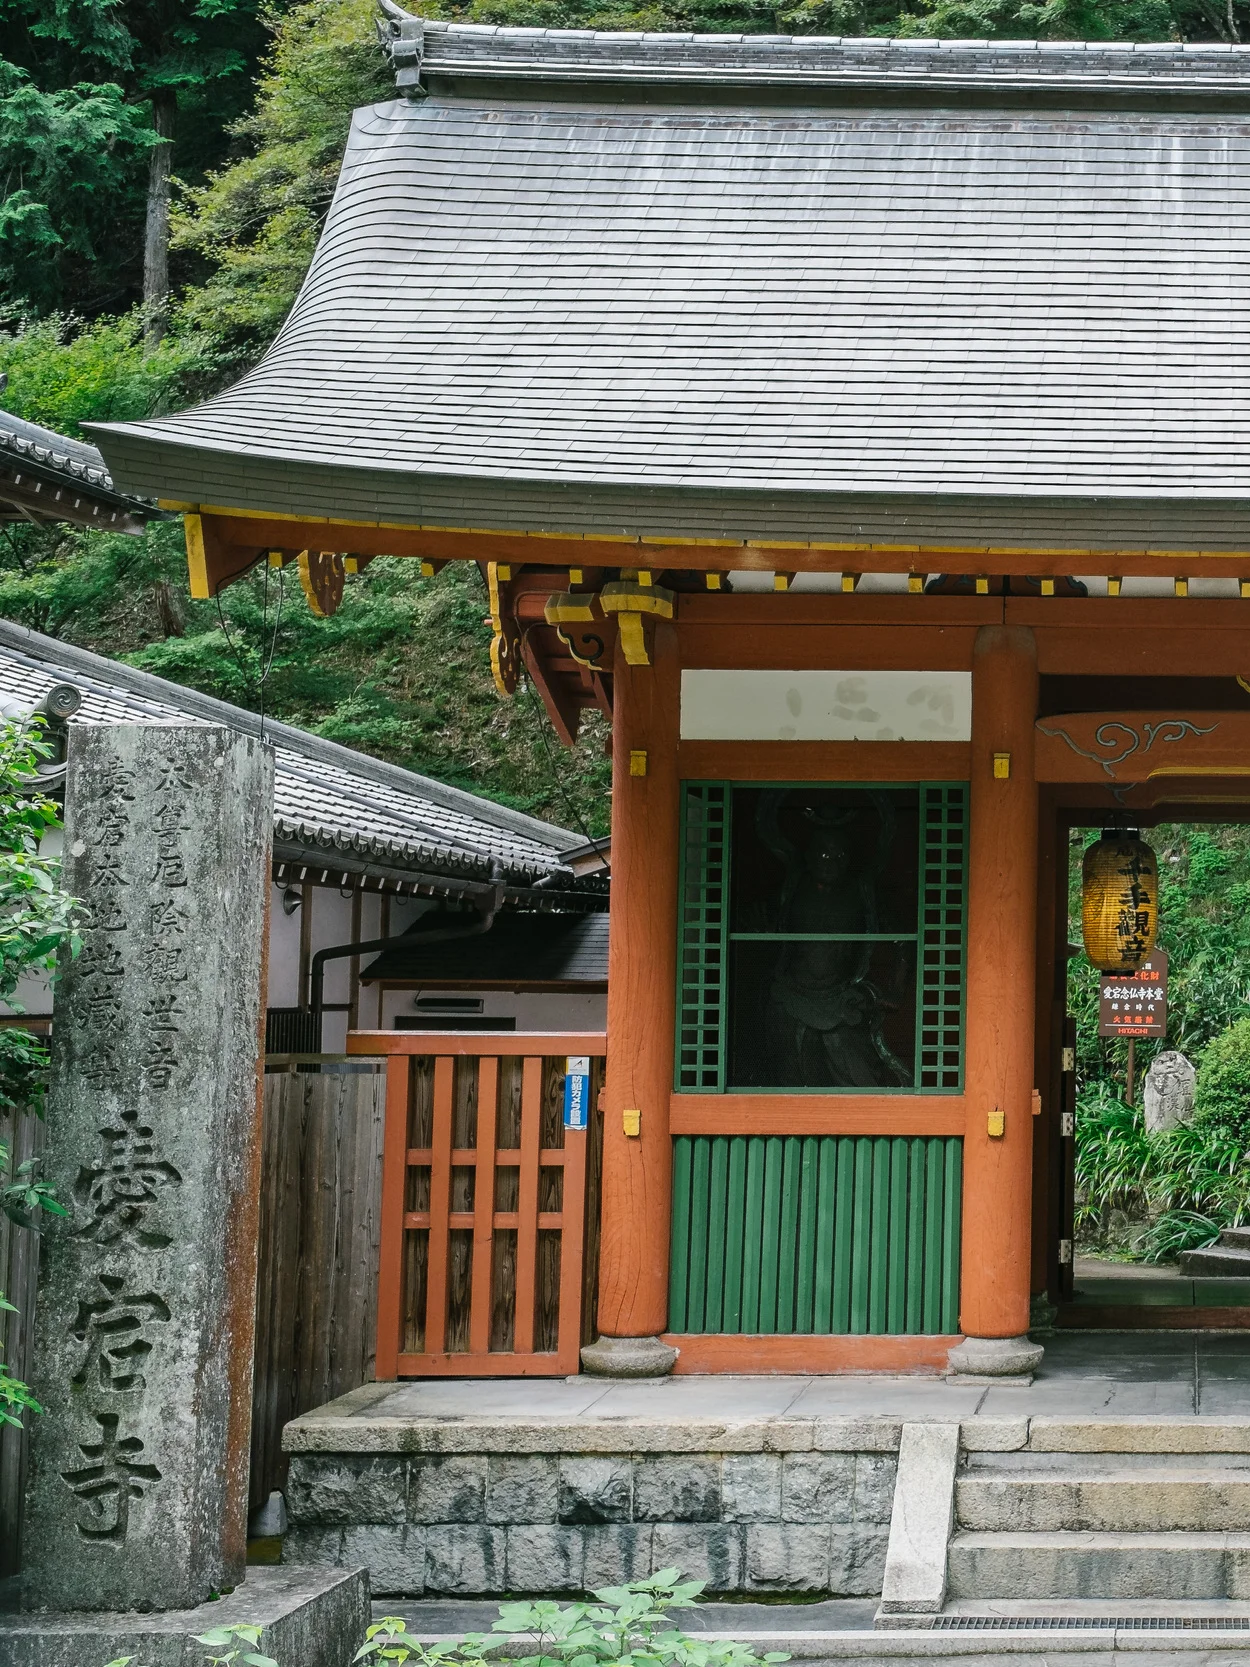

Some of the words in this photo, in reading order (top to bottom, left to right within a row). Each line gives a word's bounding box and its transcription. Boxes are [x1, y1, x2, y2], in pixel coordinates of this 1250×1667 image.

[1103, 986, 1164, 1001] 愛宕念仏寺本堂
[1117, 1027, 1149, 1035] HITACHI
[60, 1109, 182, 1547] 愛宕寺
